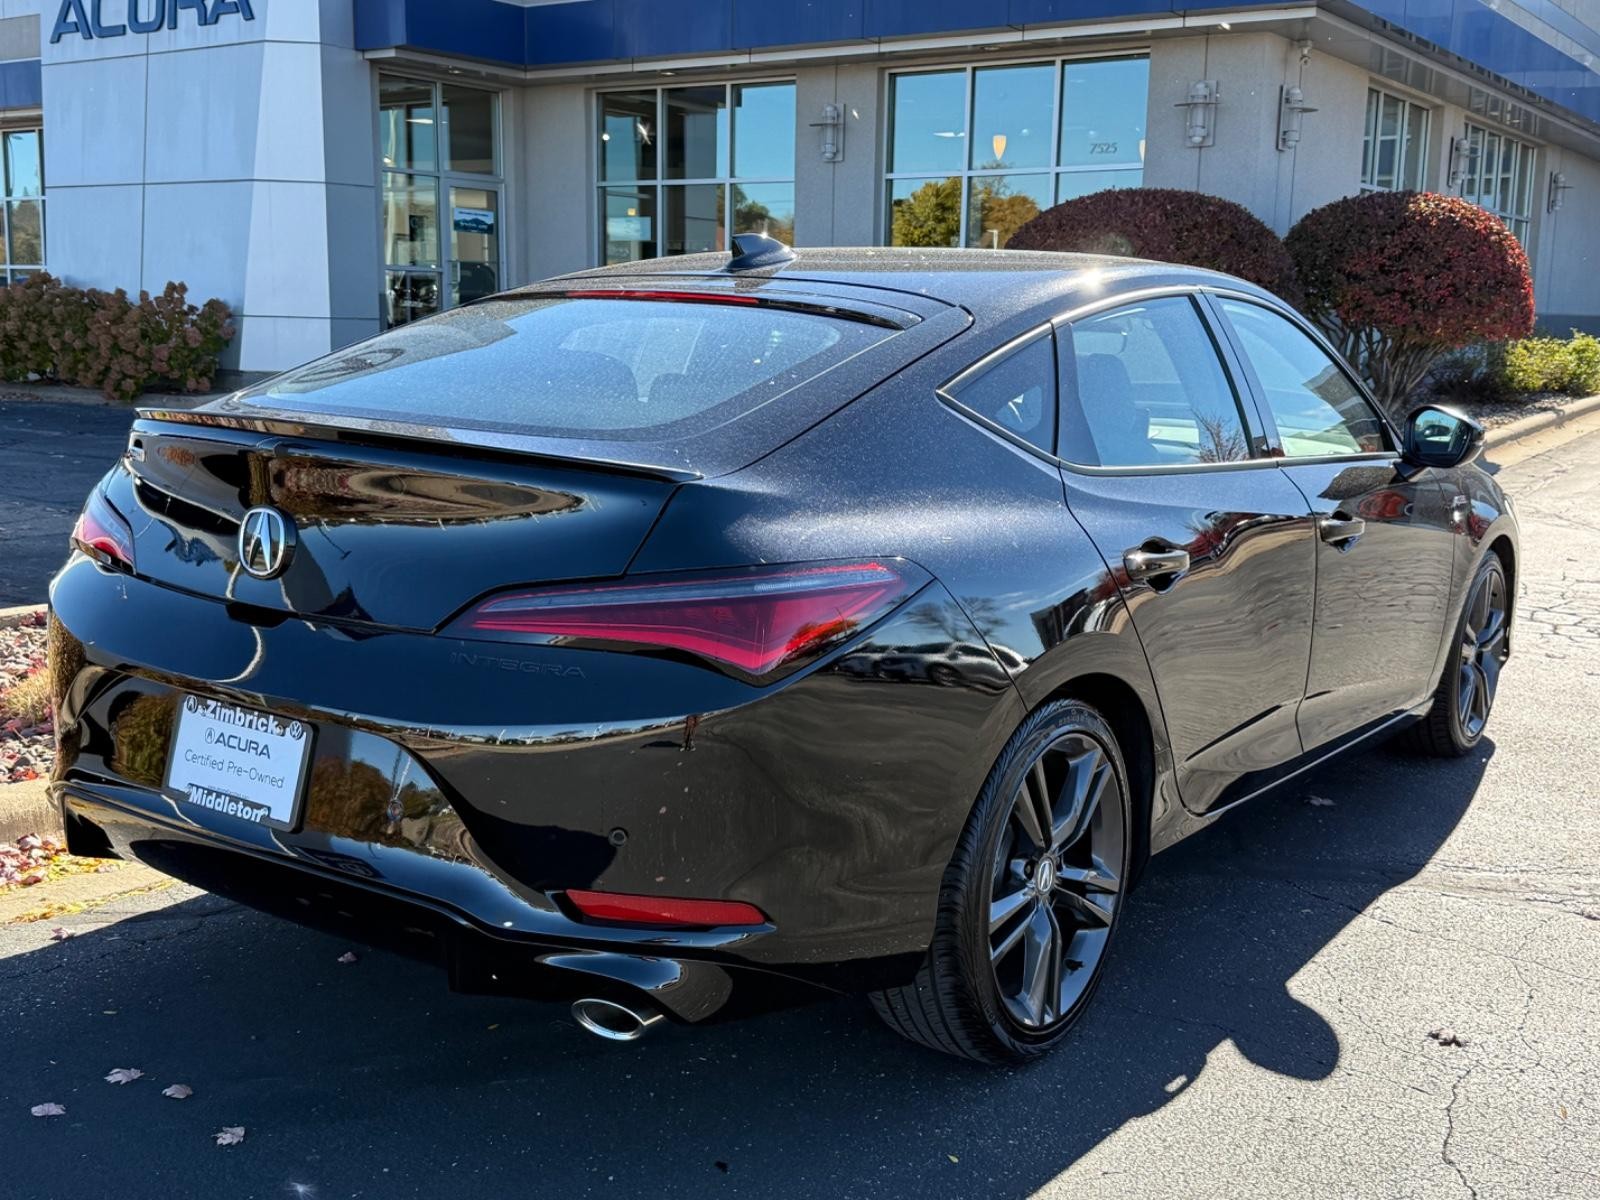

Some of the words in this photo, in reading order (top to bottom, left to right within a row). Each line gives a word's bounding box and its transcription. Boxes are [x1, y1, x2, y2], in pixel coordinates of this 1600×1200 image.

[1090, 142, 1118, 154] 7525
[451, 652, 586, 679] INTEGRA
[205, 700, 279, 736] Zimbrick
[215, 732, 271, 759] ACURA
[184, 748, 225, 771] Certified
[226, 760, 285, 789] Pre-Owned
[188, 785, 262, 823] Middleton
